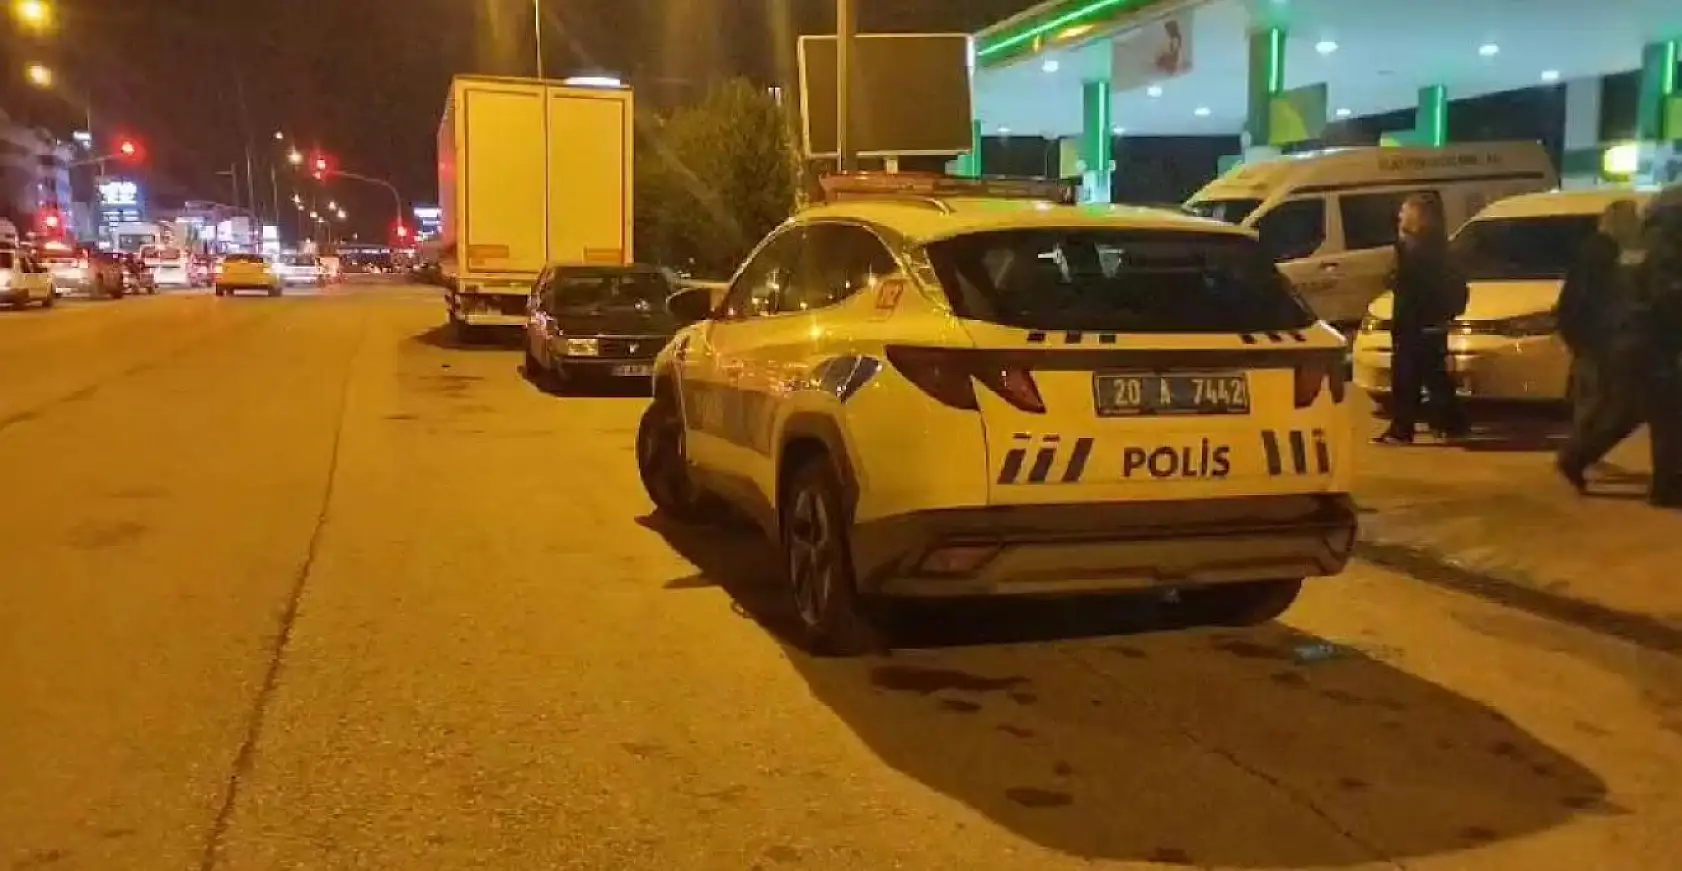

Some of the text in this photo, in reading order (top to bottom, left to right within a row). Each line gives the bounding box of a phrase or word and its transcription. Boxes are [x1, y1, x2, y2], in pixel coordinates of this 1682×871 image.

[1114, 378, 1244, 406] 20 A 7442
[1123, 437, 1231, 478] POLİS
